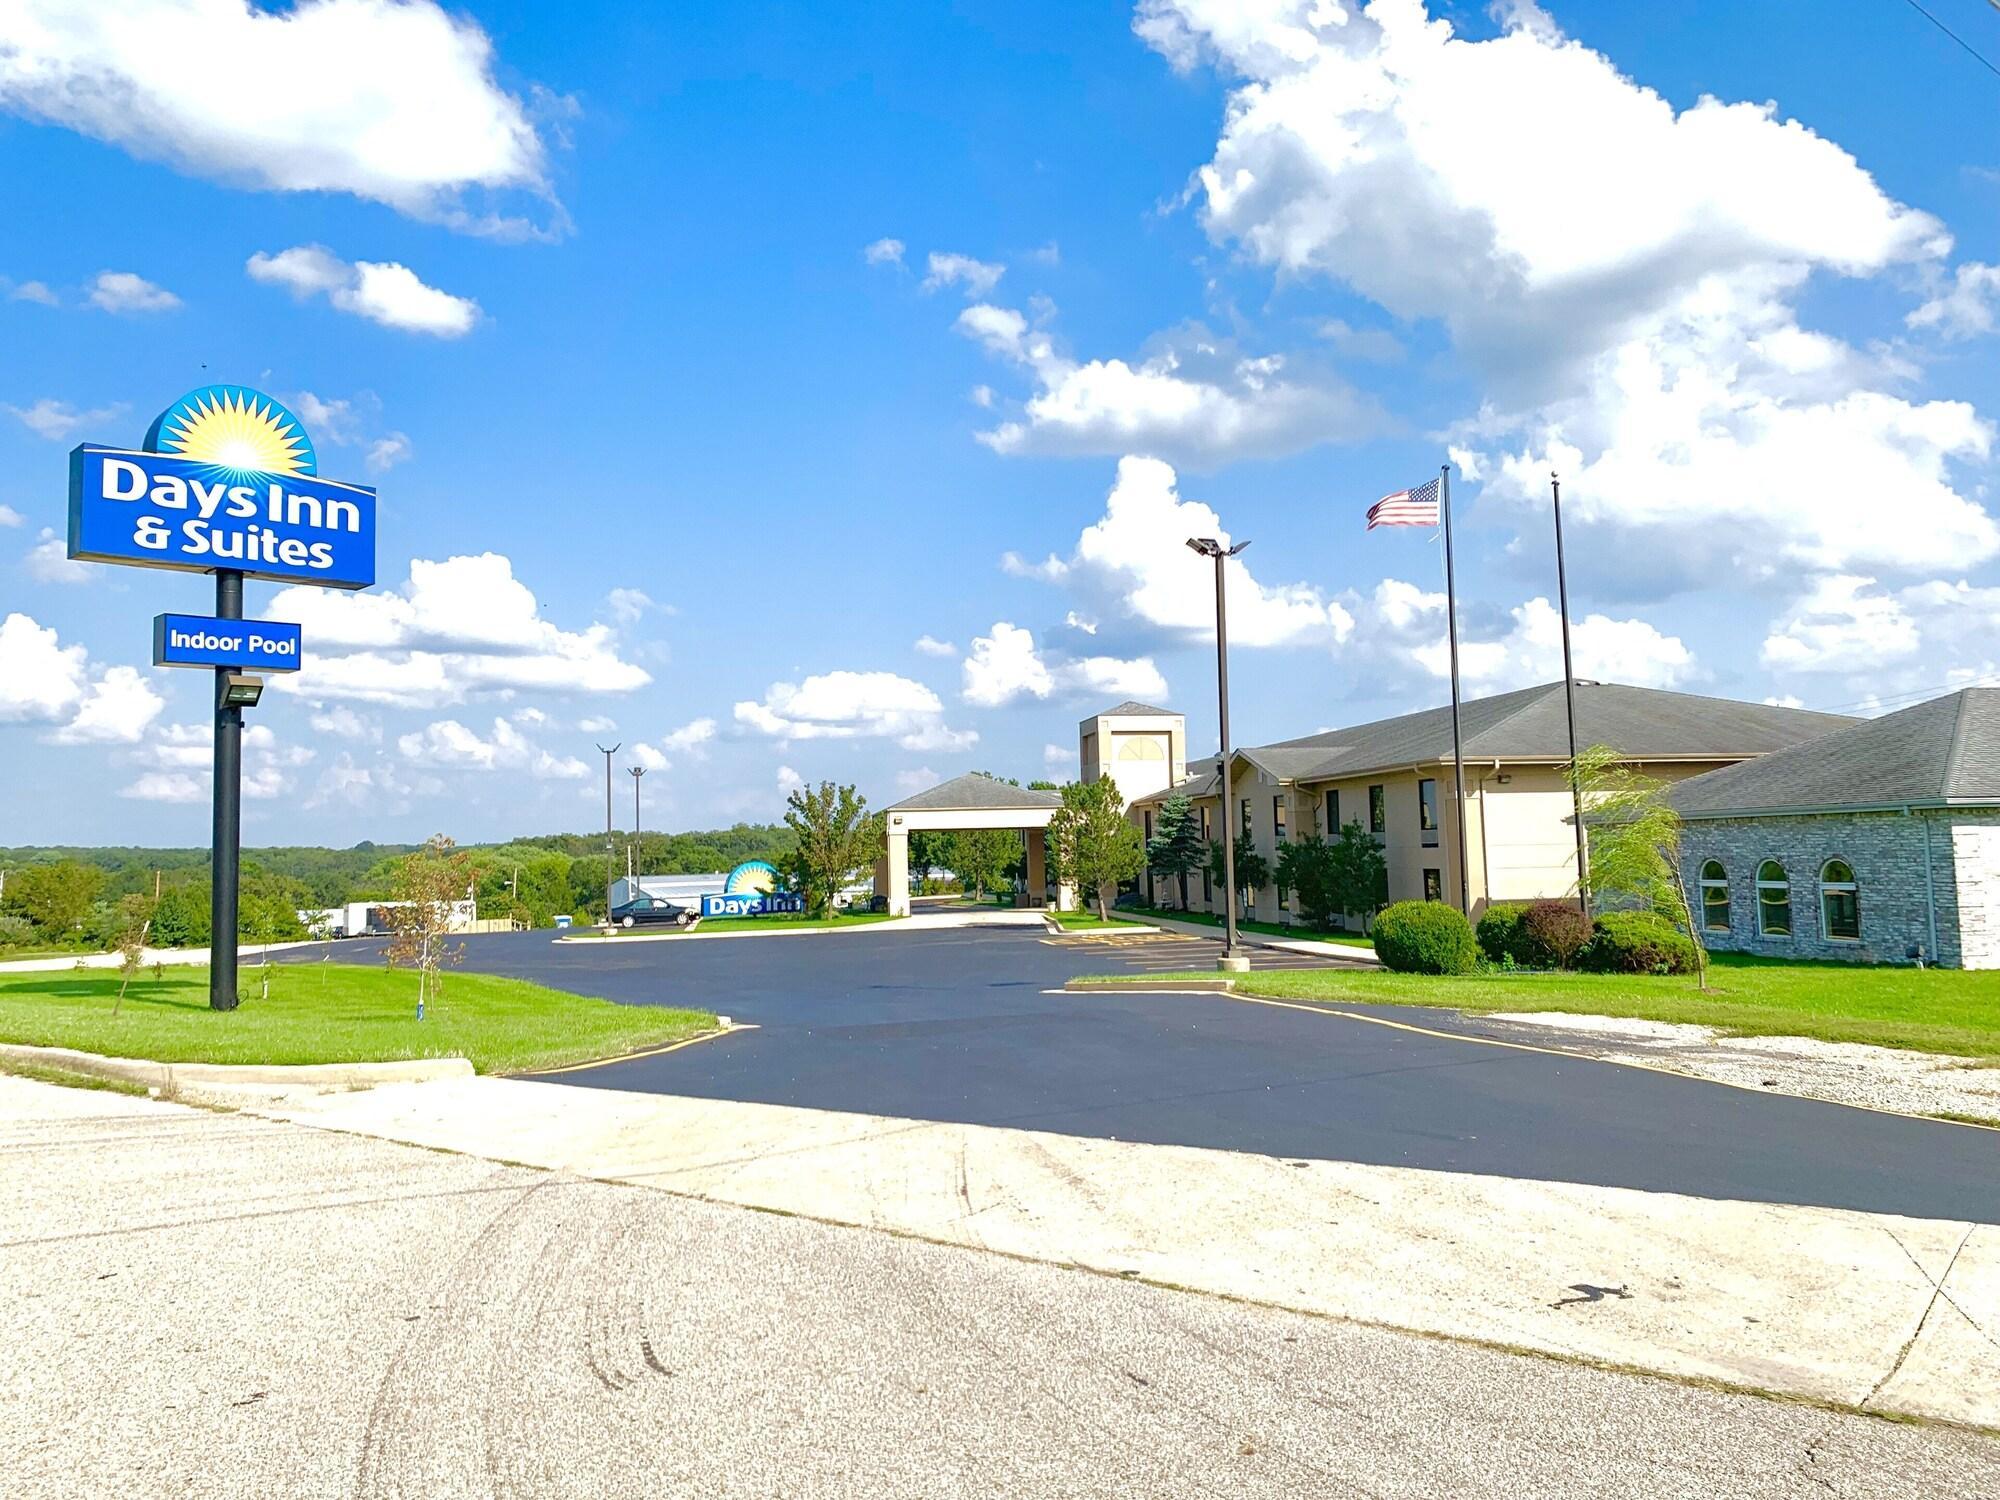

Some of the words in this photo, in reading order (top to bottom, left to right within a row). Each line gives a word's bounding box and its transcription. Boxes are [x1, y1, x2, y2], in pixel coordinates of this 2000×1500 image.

[102, 458, 258, 519] Days
[268, 484, 360, 533] Inn
[133, 516, 172, 550] &
[181, 519, 334, 569] Suites
[170, 629, 242, 652] Indoor
[248, 634, 296, 656] Pool
[709, 897, 763, 915] Days
[766, 896, 801, 912] Inn
